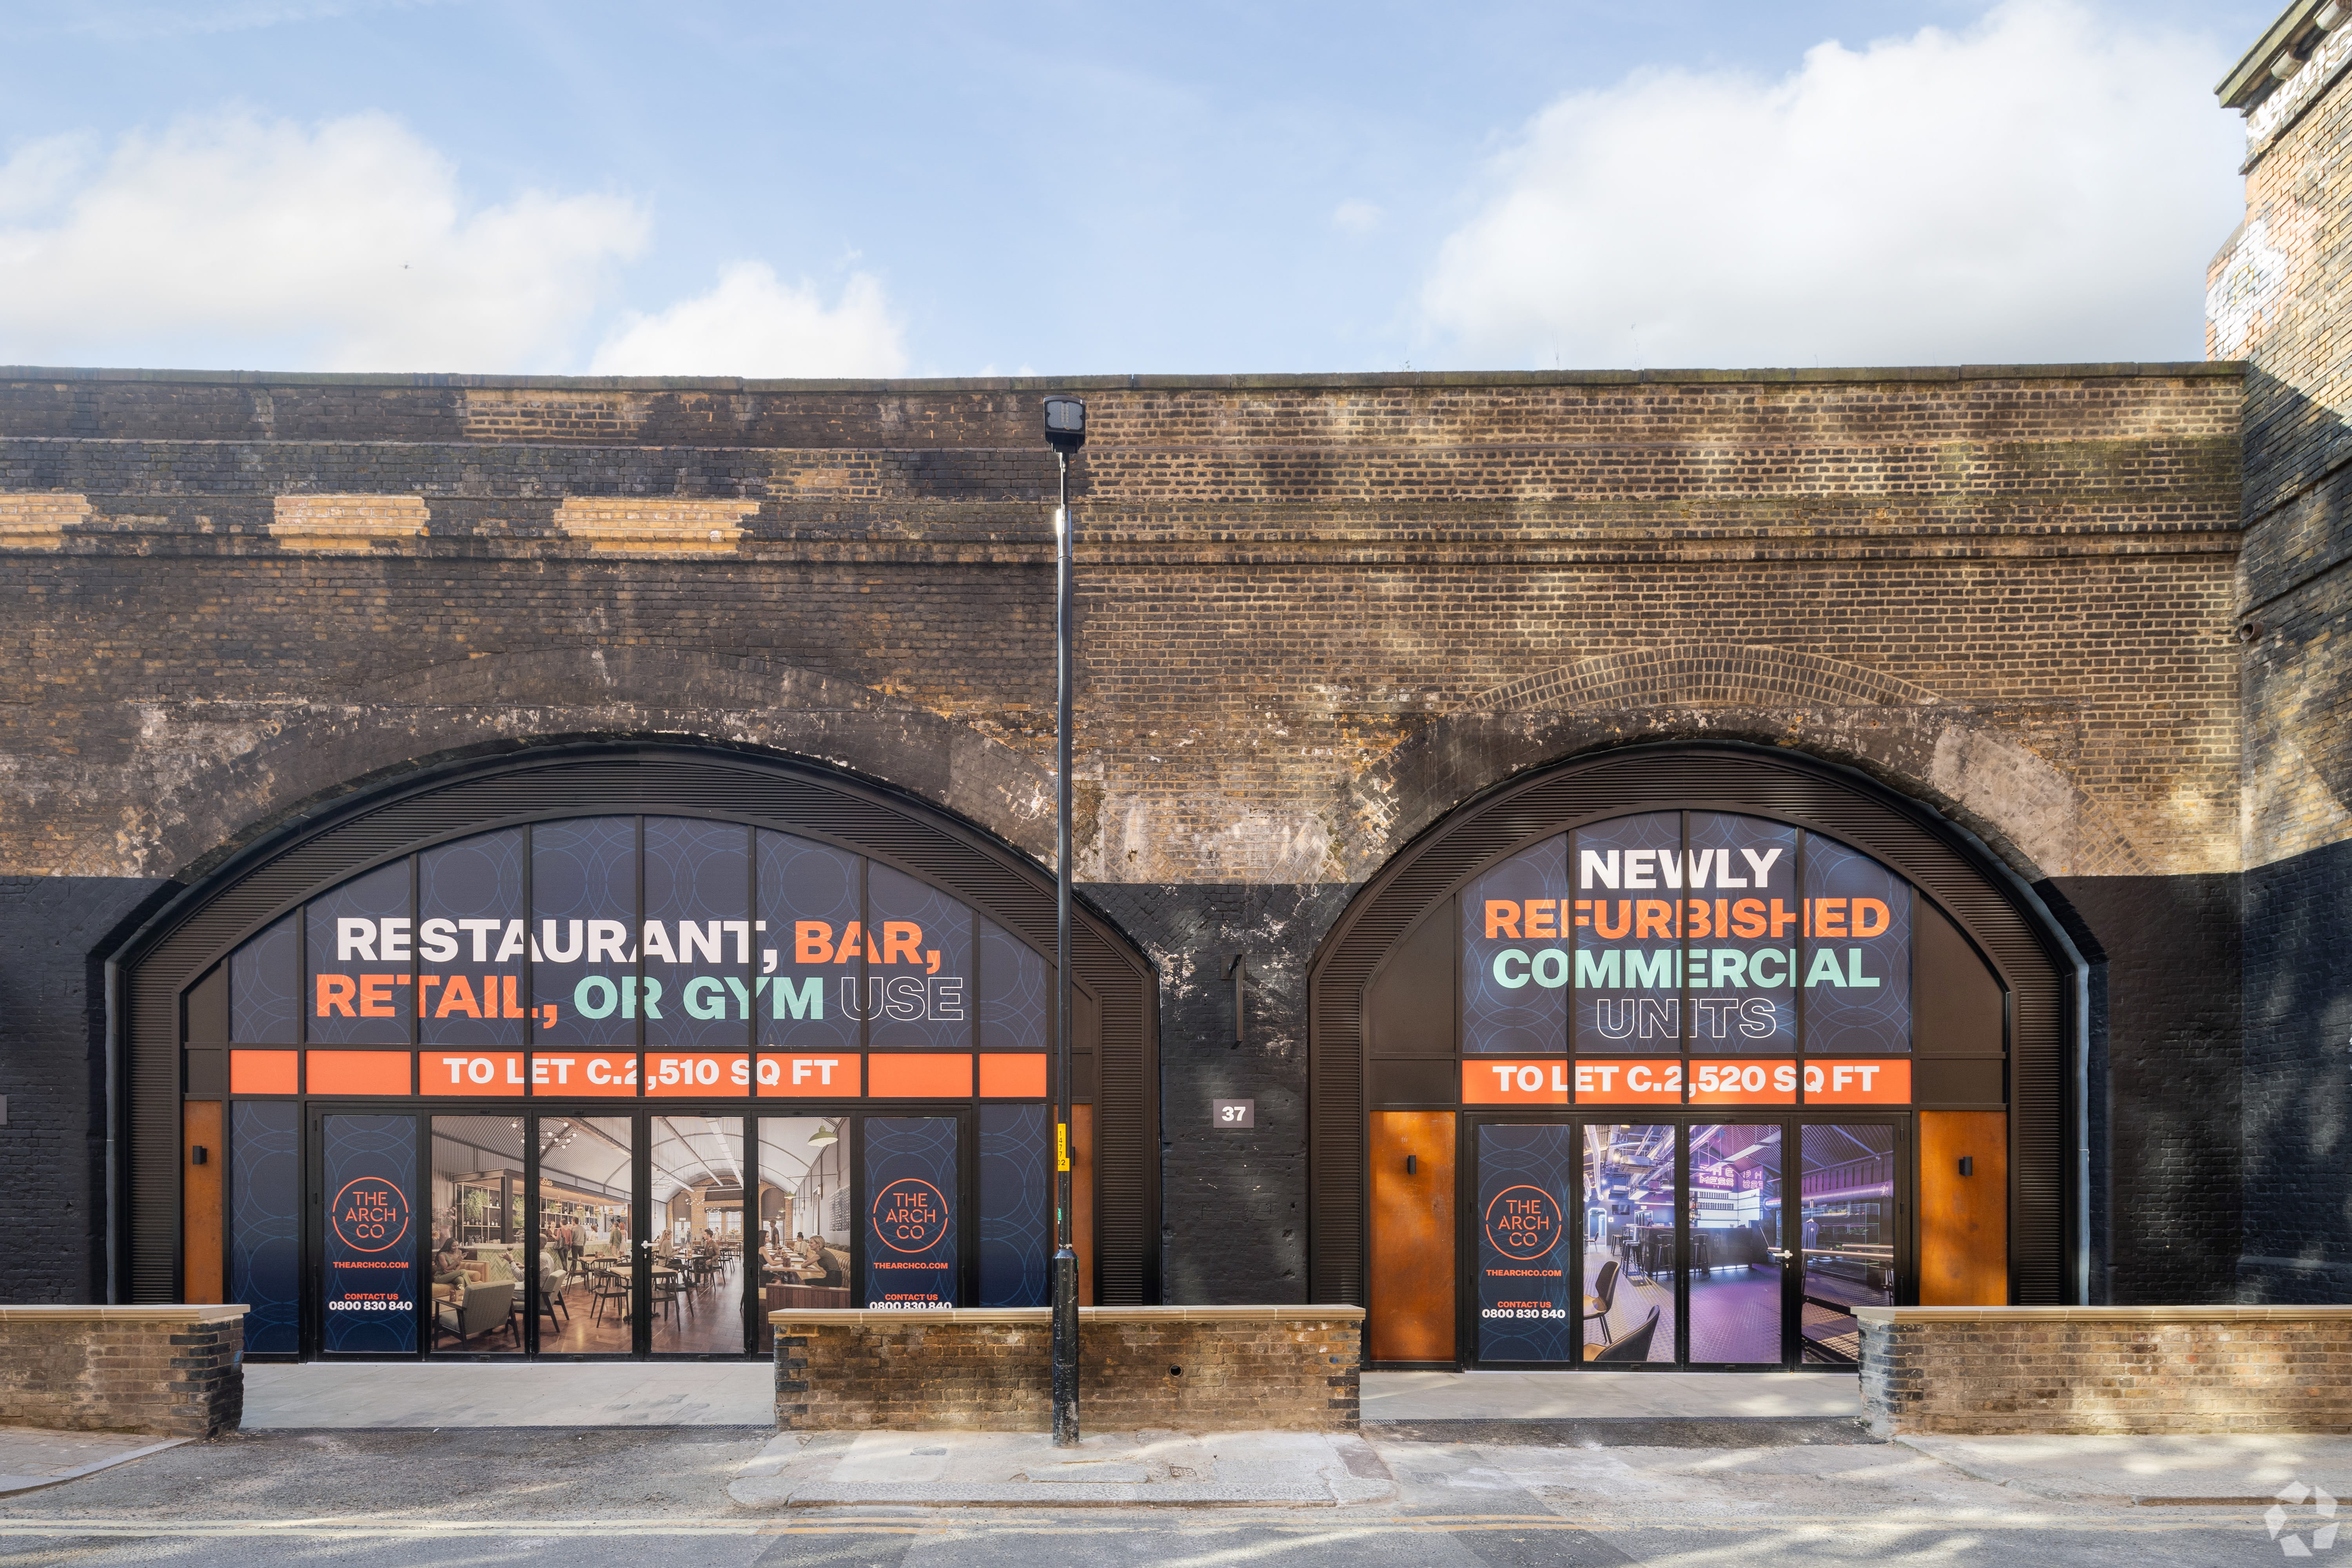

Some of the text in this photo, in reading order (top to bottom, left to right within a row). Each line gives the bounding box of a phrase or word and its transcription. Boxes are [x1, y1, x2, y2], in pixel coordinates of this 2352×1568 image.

[1581, 849, 1782, 889] NEWLY
[1486, 898, 1890, 939] REFURBISHED
[338, 918, 940, 974] RESTAURANT, BAR,
[1493, 948, 1880, 988] COMMERCIAL
[317, 975, 963, 1029] RETAIL, OR GYM USE
[1597, 998, 1776, 1039] UNITS
[443, 1058, 838, 1090] TO LET C.2,510 SQ FT
[1493, 1066, 1879, 1097] TO LET C.2,520 SQ FT
[1221, 1106, 1246, 1122] 37
[1699, 1176, 1734, 1187] MESS
[352, 1191, 388, 1206] THE
[893, 1193, 928, 1207] THE
[345, 1207, 396, 1222] ARCH
[1506, 1200, 1541, 1214] THE
[886, 1209, 936, 1223] ARCH
[1498, 1215, 1549, 1230] ARCH
[356, 1224, 385, 1238] CO
[896, 1225, 924, 1239] CO
[1509, 1232, 1537, 1247] CO
[329, 1301, 413, 1310] 0800 830 840
[1482, 1309, 1566, 1318] 0800 830 840
